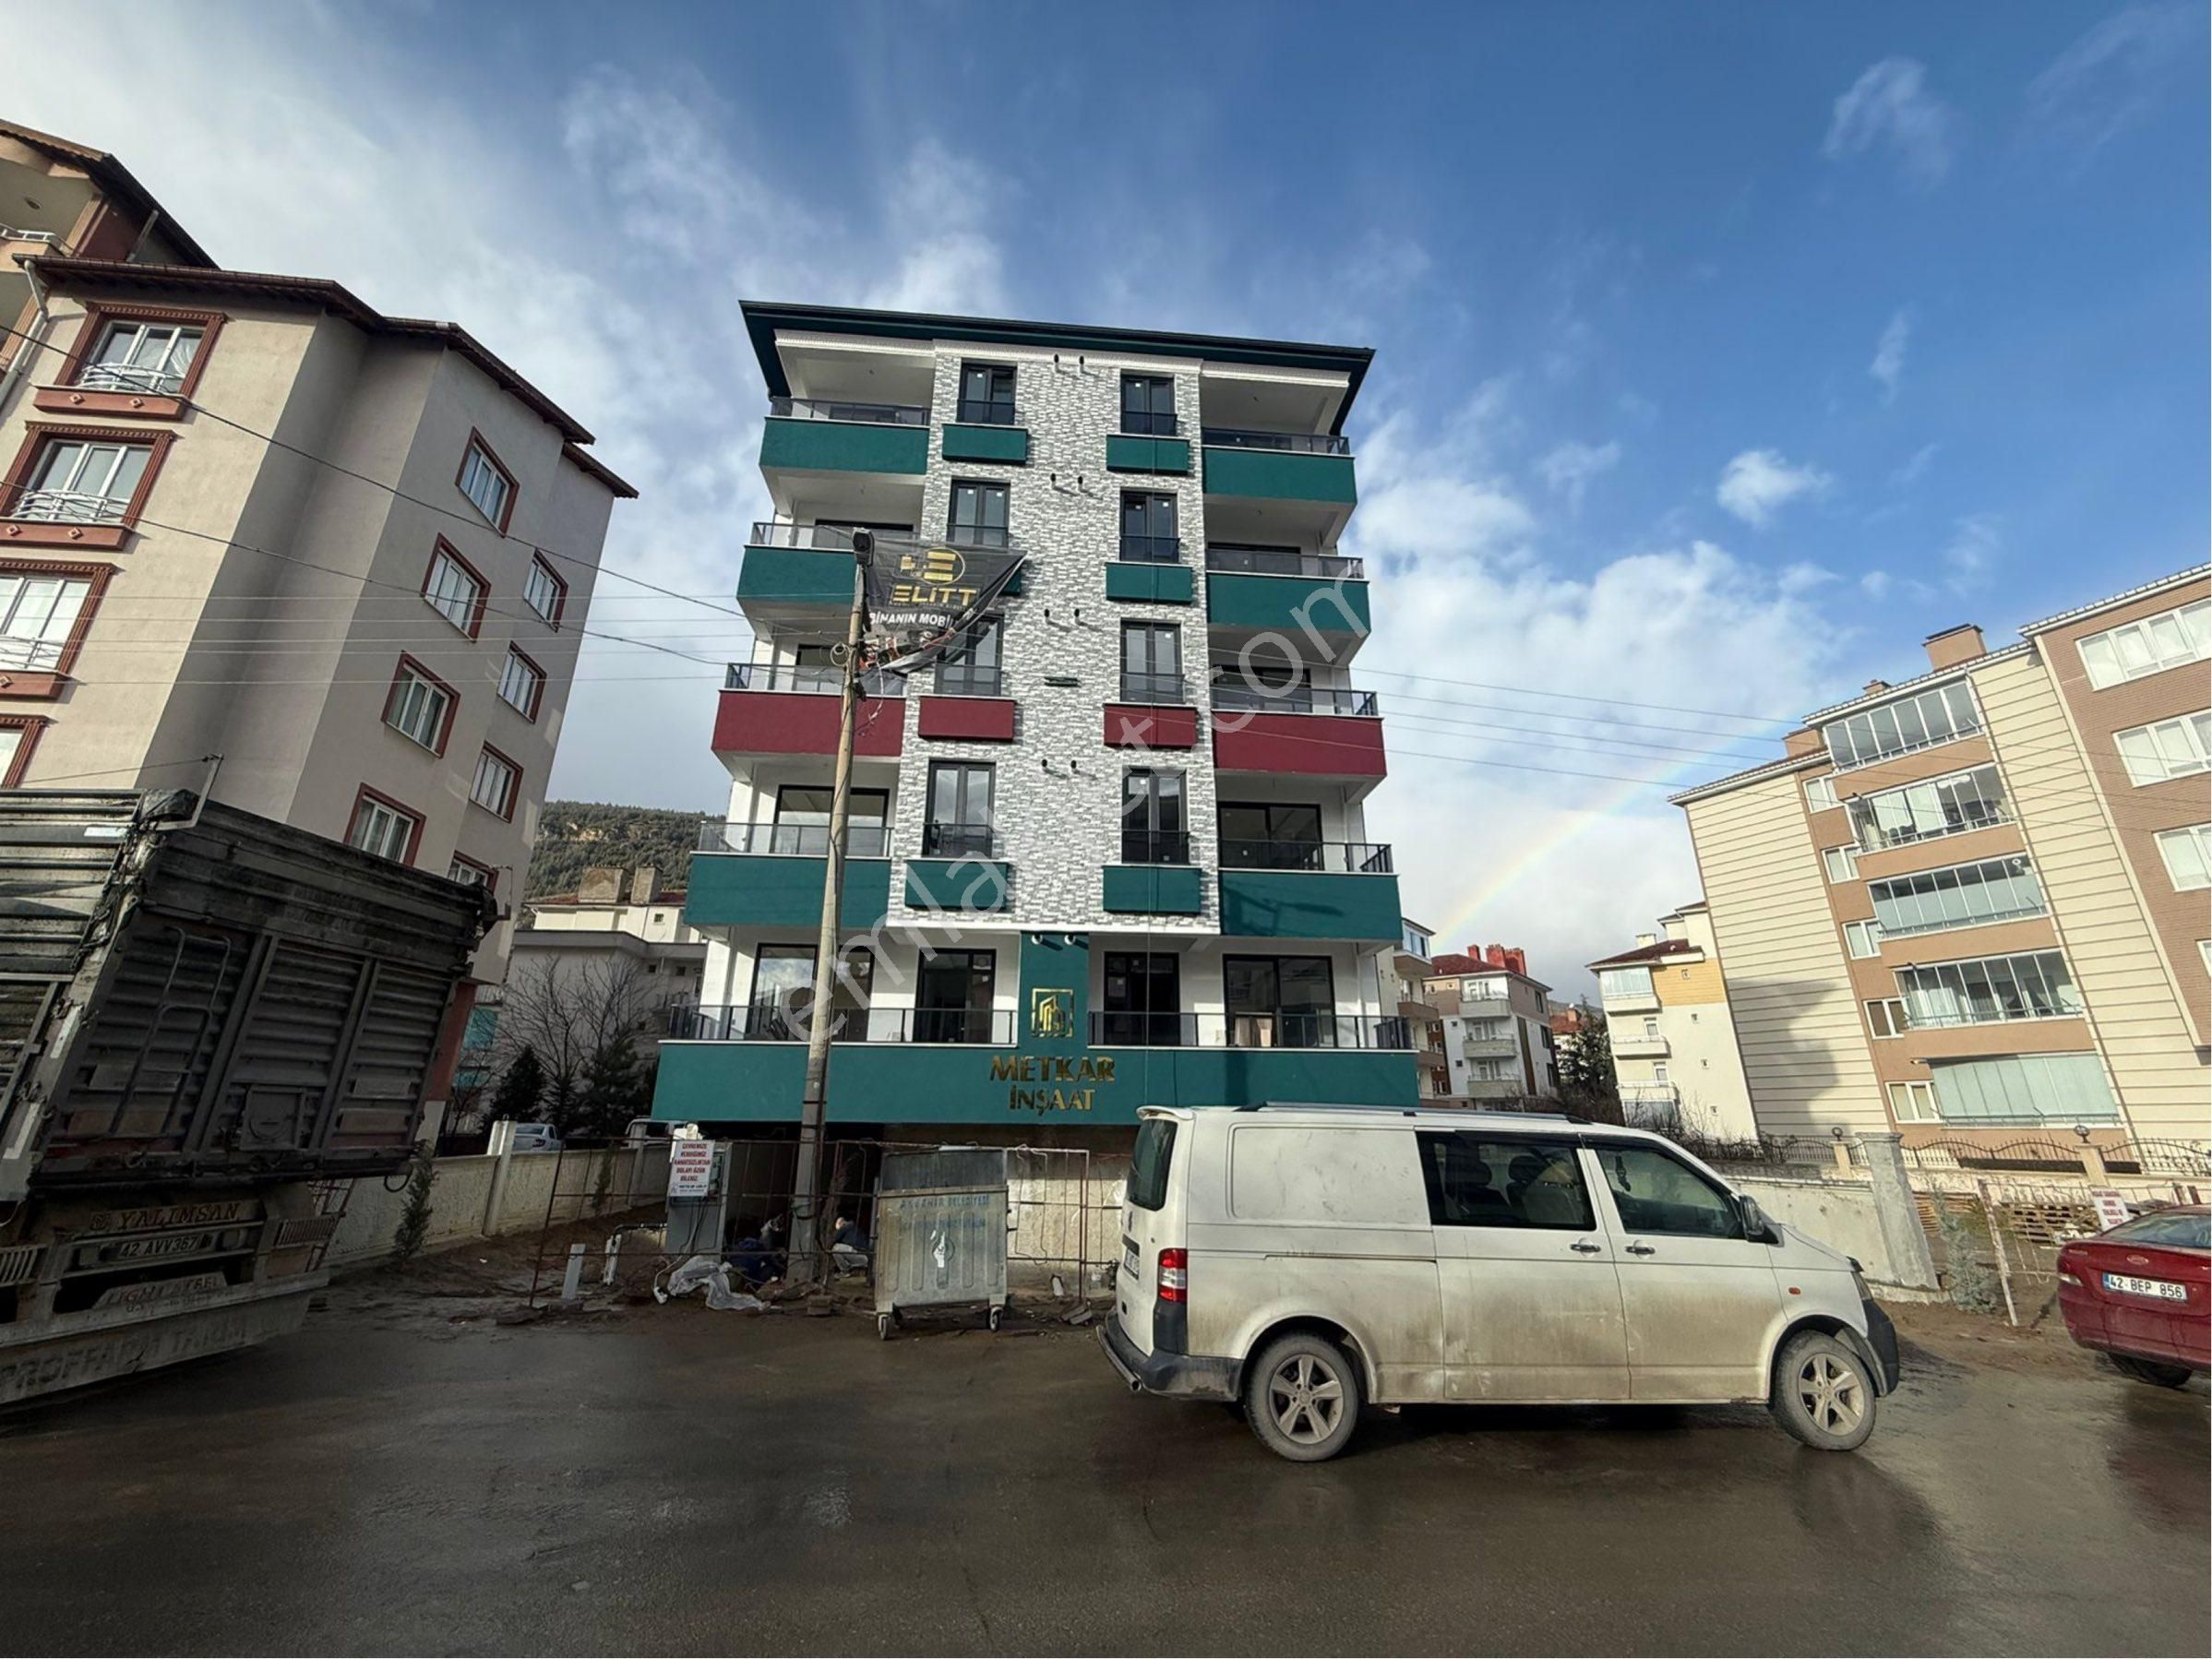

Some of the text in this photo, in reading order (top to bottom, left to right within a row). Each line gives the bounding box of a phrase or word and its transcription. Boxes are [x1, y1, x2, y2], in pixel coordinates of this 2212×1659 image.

[989, 1055, 1116, 1082] METKAR
[1009, 1083, 1096, 1116] İNŞAAT
[120, 1242, 141, 1258] 42
[2110, 1275, 2183, 1298] 42 BEP 856
